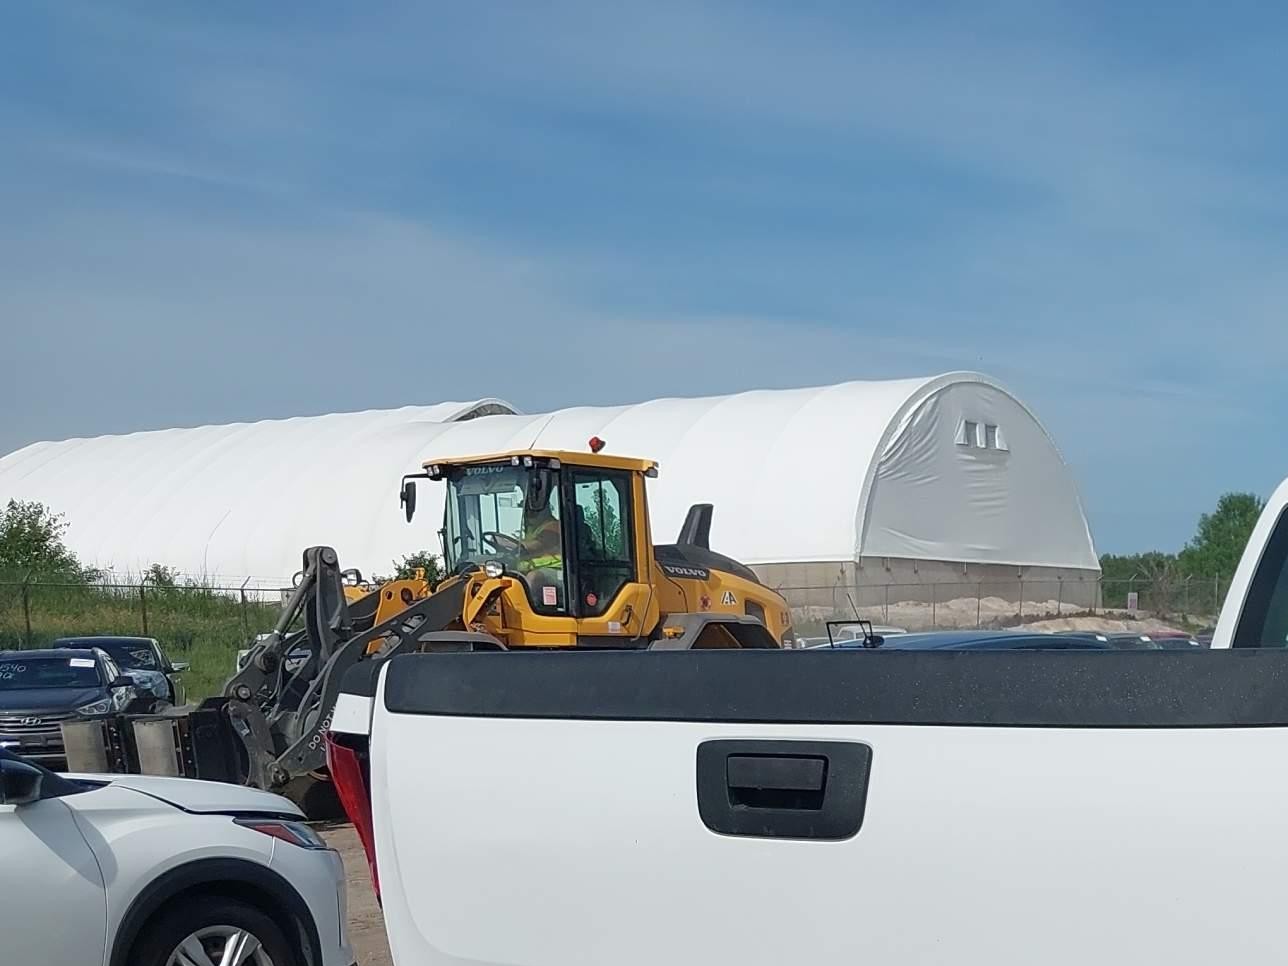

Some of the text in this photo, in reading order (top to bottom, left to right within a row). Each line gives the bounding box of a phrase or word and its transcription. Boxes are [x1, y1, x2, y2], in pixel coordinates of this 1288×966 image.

[466, 466, 503, 476] VOLVO
[665, 566, 706, 577] VOLVO
[308, 734, 321, 750] DO
